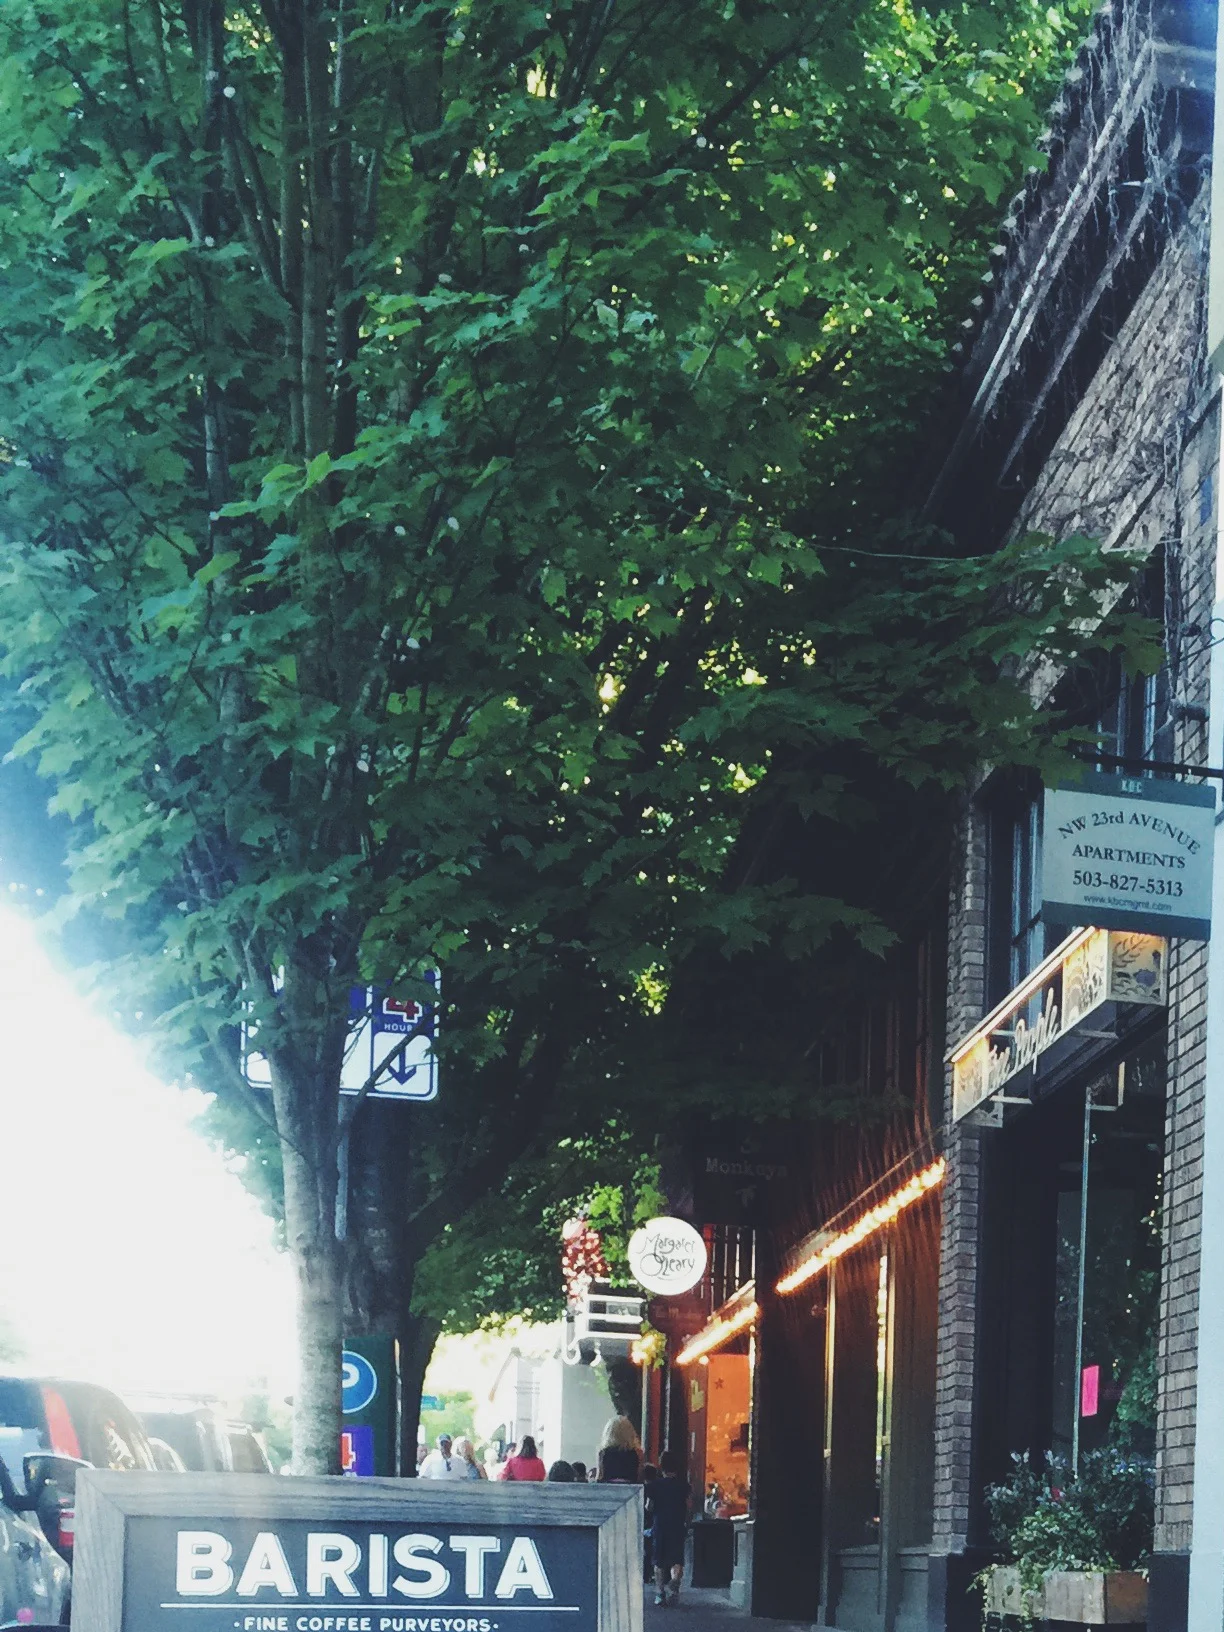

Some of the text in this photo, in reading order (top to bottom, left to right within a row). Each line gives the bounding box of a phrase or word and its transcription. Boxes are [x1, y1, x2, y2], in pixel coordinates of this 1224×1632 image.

[1057, 811, 1201, 855] NW 23rd AVENUE
[1072, 844, 1186, 869] APARTMENTS
[1072, 870, 1184, 897] 503-827-5313
[636, 1233, 696, 1254] Margaret
[176, 1530, 554, 1599] BARISTA
[243, 1617, 491, 1632] FINE COFFEE PURVEYORS
